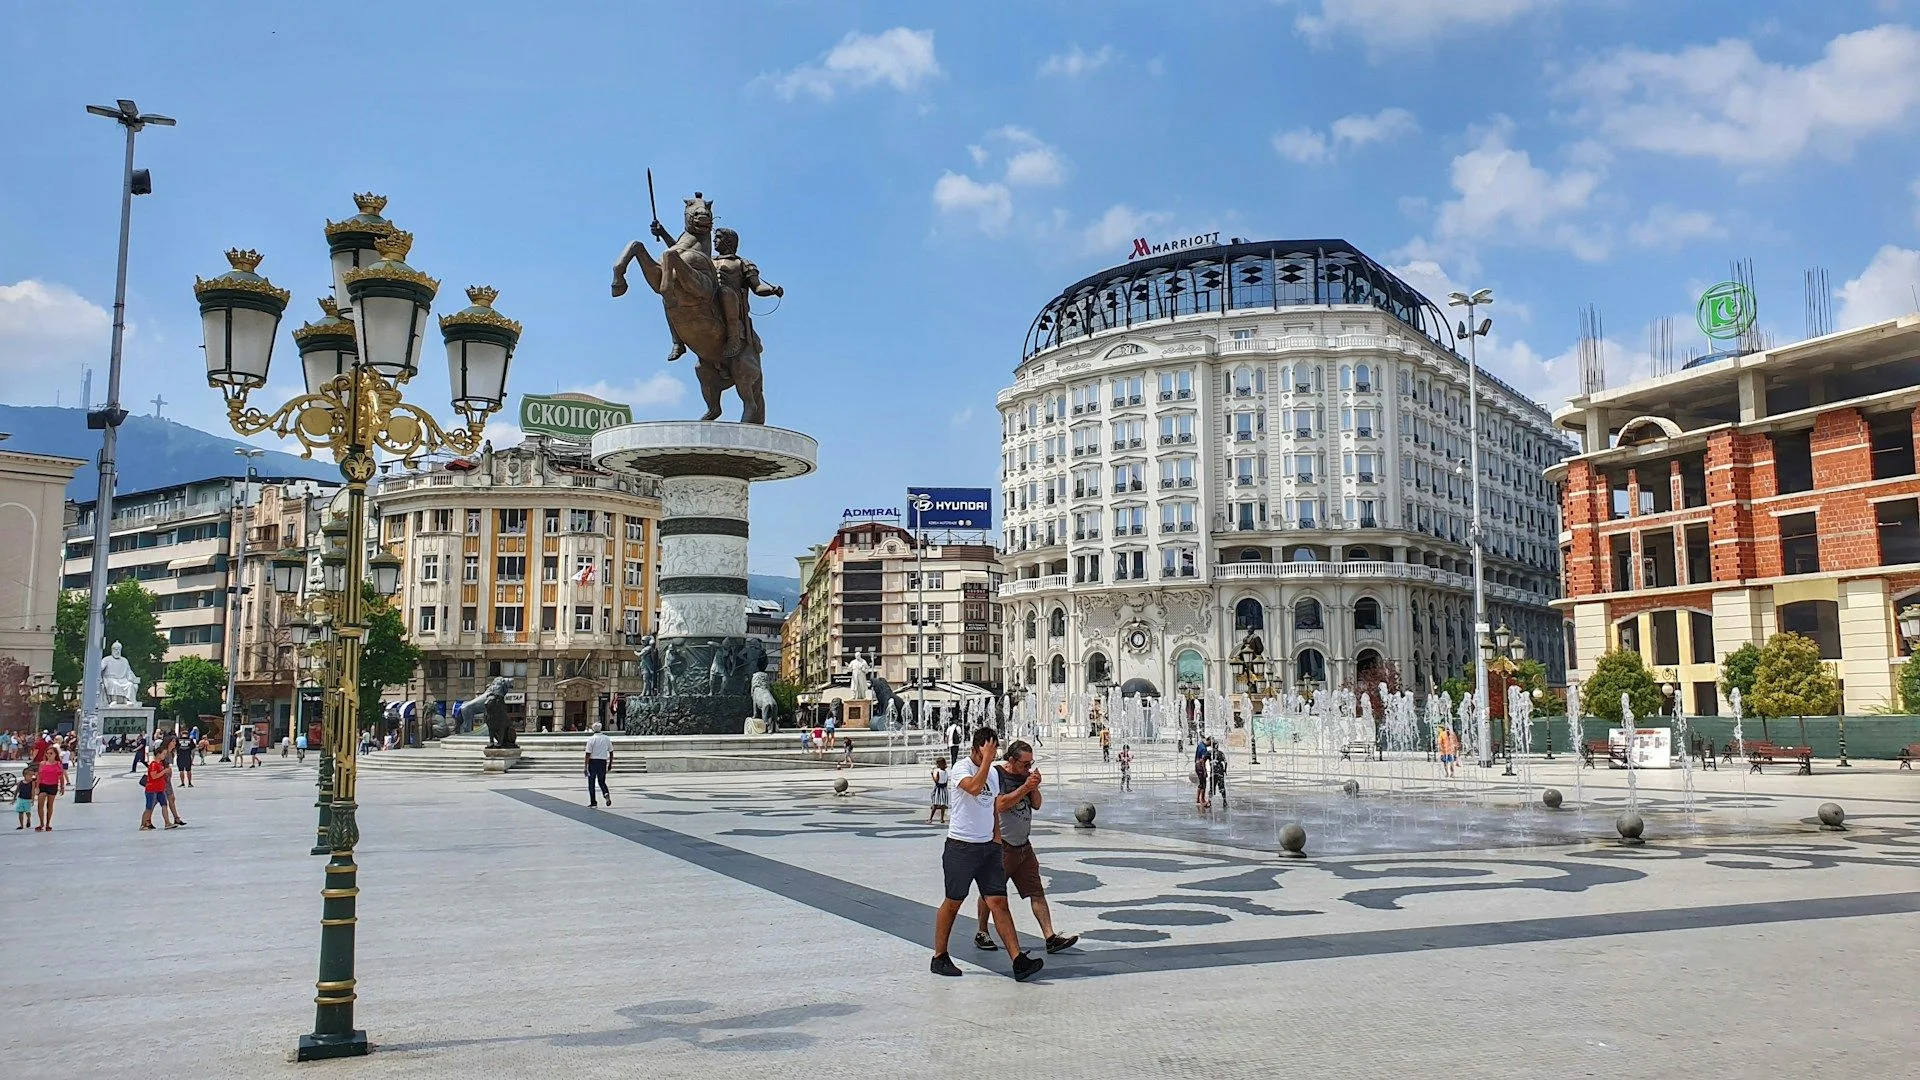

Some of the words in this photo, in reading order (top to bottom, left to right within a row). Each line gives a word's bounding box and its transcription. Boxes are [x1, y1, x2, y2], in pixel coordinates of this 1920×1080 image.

[1152, 231, 1220, 254] MARRIOTT
[526, 402, 627, 430] СКОПСКО
[842, 507, 902, 518] ADMIRAL
[935, 501, 988, 511] HYUNDAI
